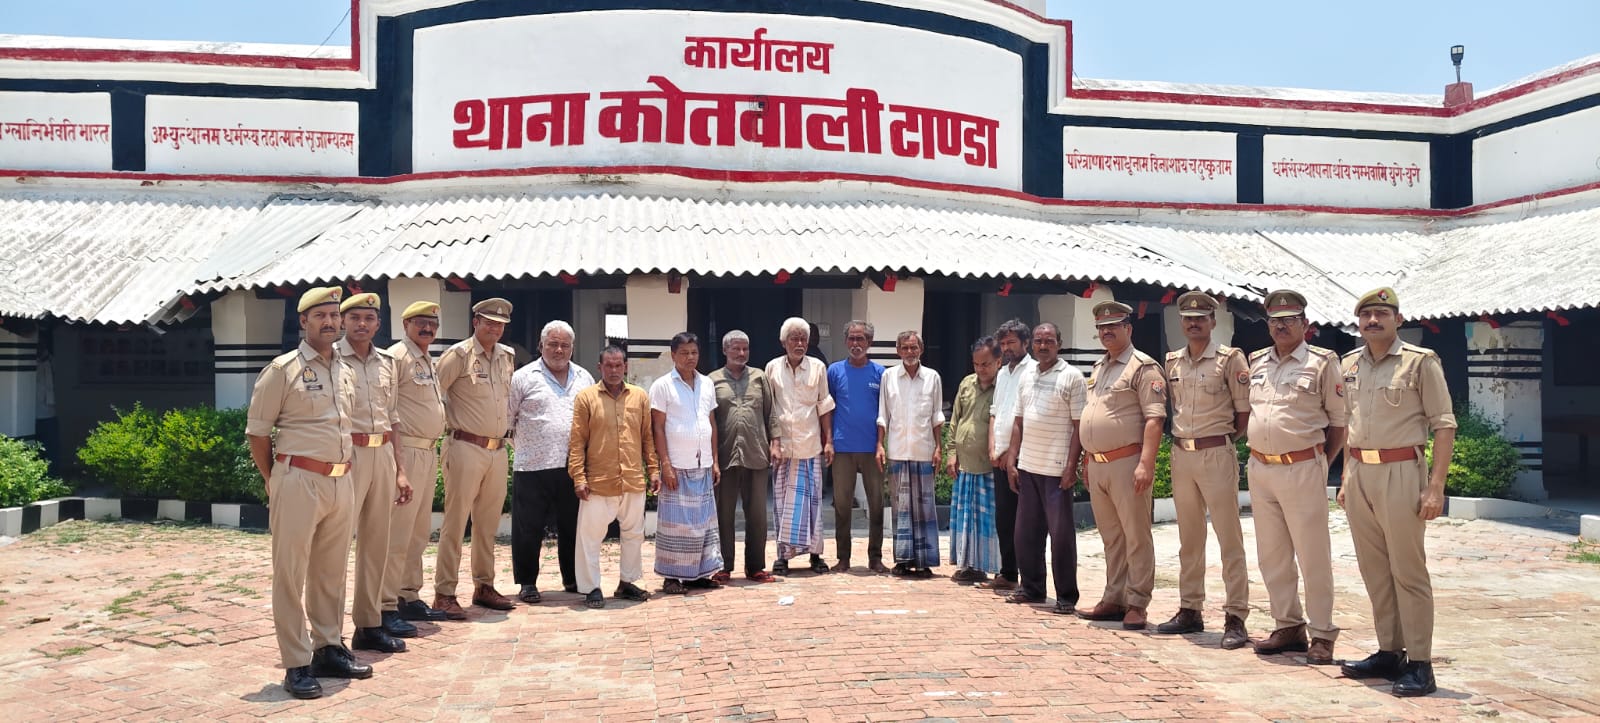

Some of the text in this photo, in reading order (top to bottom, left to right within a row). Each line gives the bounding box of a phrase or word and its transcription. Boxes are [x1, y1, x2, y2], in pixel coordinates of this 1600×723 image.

[684, 26, 835, 75] कार्यालय
[79, 124, 111, 144] भारत
[452, 75, 1000, 169] थाना कोतवाली टाण्डा
[1188, 158, 1197, 174] च
